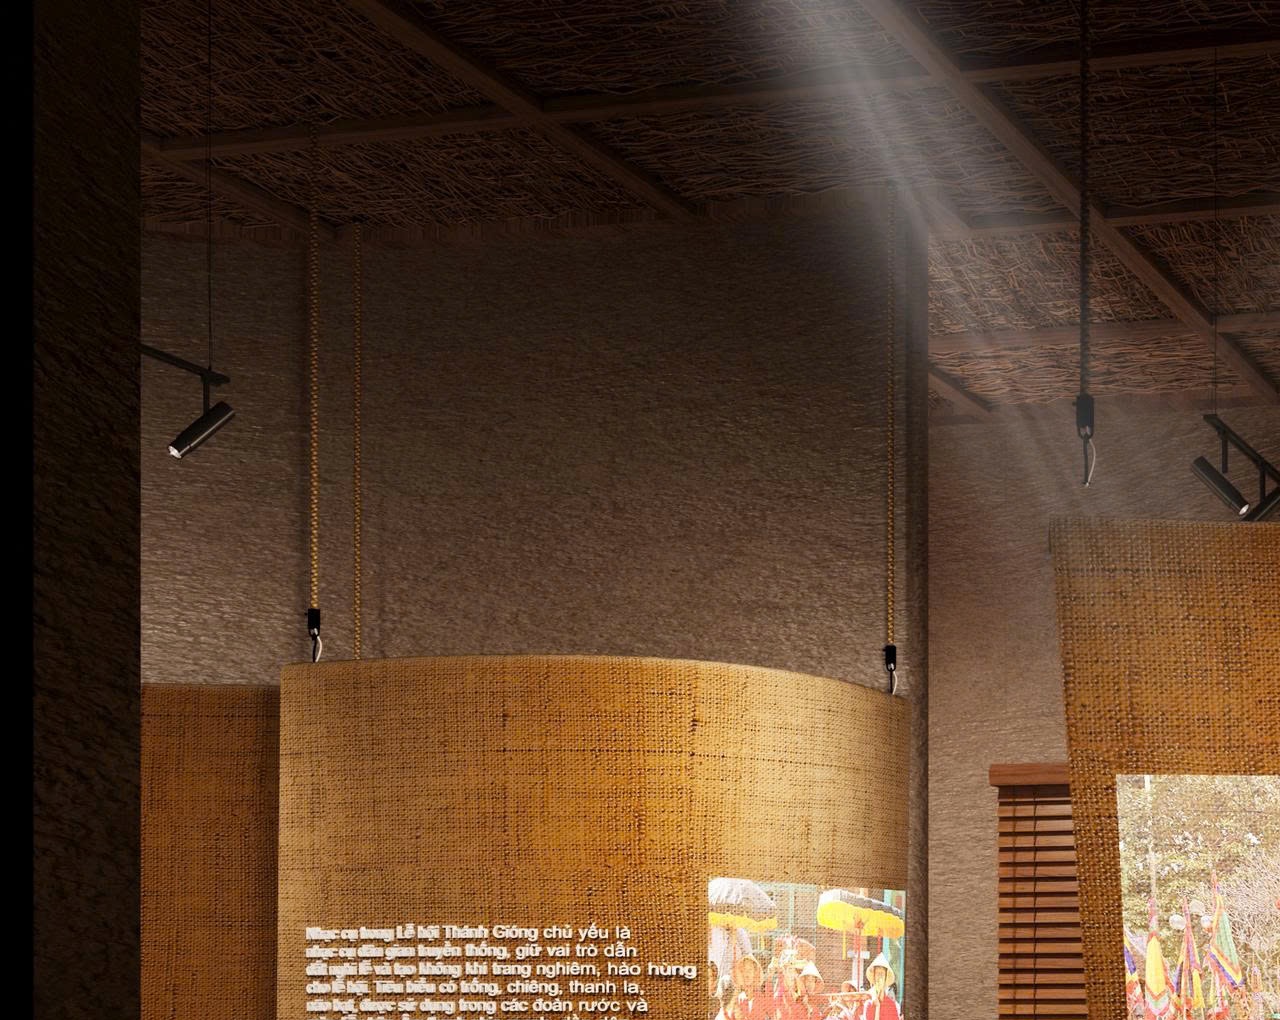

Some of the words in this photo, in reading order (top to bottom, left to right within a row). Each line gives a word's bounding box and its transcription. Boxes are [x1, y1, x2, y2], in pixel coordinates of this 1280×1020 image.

[396, 922, 416, 939] Lễ
[442, 924, 489, 939] Thánh
[492, 924, 539, 942] Gióng
[543, 925, 573, 939] chủ
[578, 923, 609, 942] yếu
[615, 926, 631, 940] là
[515, 943, 542, 960] giữ
[546, 946, 570, 957] vai
[575, 944, 598, 957] trò
[603, 940, 637, 958] dẫn
[492, 961, 532, 979] trang
[536, 961, 601, 979] nghiêm,
[607, 962, 642, 976] hào
[647, 962, 698, 980] hùng
[438, 979, 458, 994] có
[506, 979, 563, 997] chiêng,
[569, 979, 616, 994] thanh
[623, 980, 644, 994] la,
[500, 998, 529, 1012] các
[532, 997, 573, 1012] đoàn
[578, 998, 621, 1012] rước
[626, 998, 648, 1012] và
